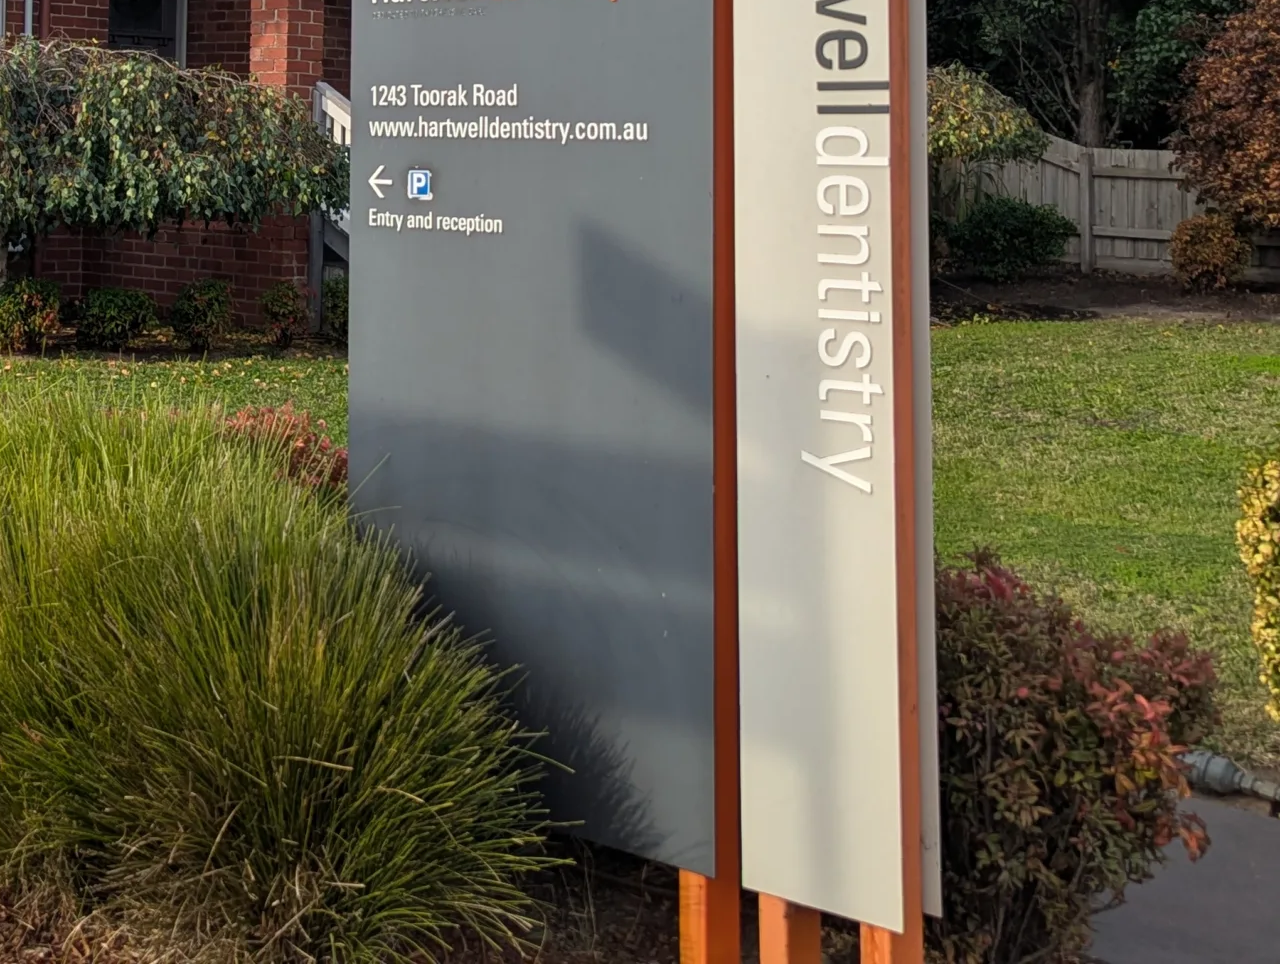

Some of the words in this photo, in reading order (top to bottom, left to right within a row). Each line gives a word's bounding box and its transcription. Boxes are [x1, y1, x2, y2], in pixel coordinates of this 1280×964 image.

[370, 85, 407, 106] 1243
[410, 84, 469, 107] Toorak
[473, 83, 518, 106] Road
[369, 116, 648, 145] www.hartwelldentistry.com.au
[412, 173, 427, 195] P
[368, 208, 404, 232] Entry
[407, 211, 433, 230] and
[436, 214, 503, 236] reception
